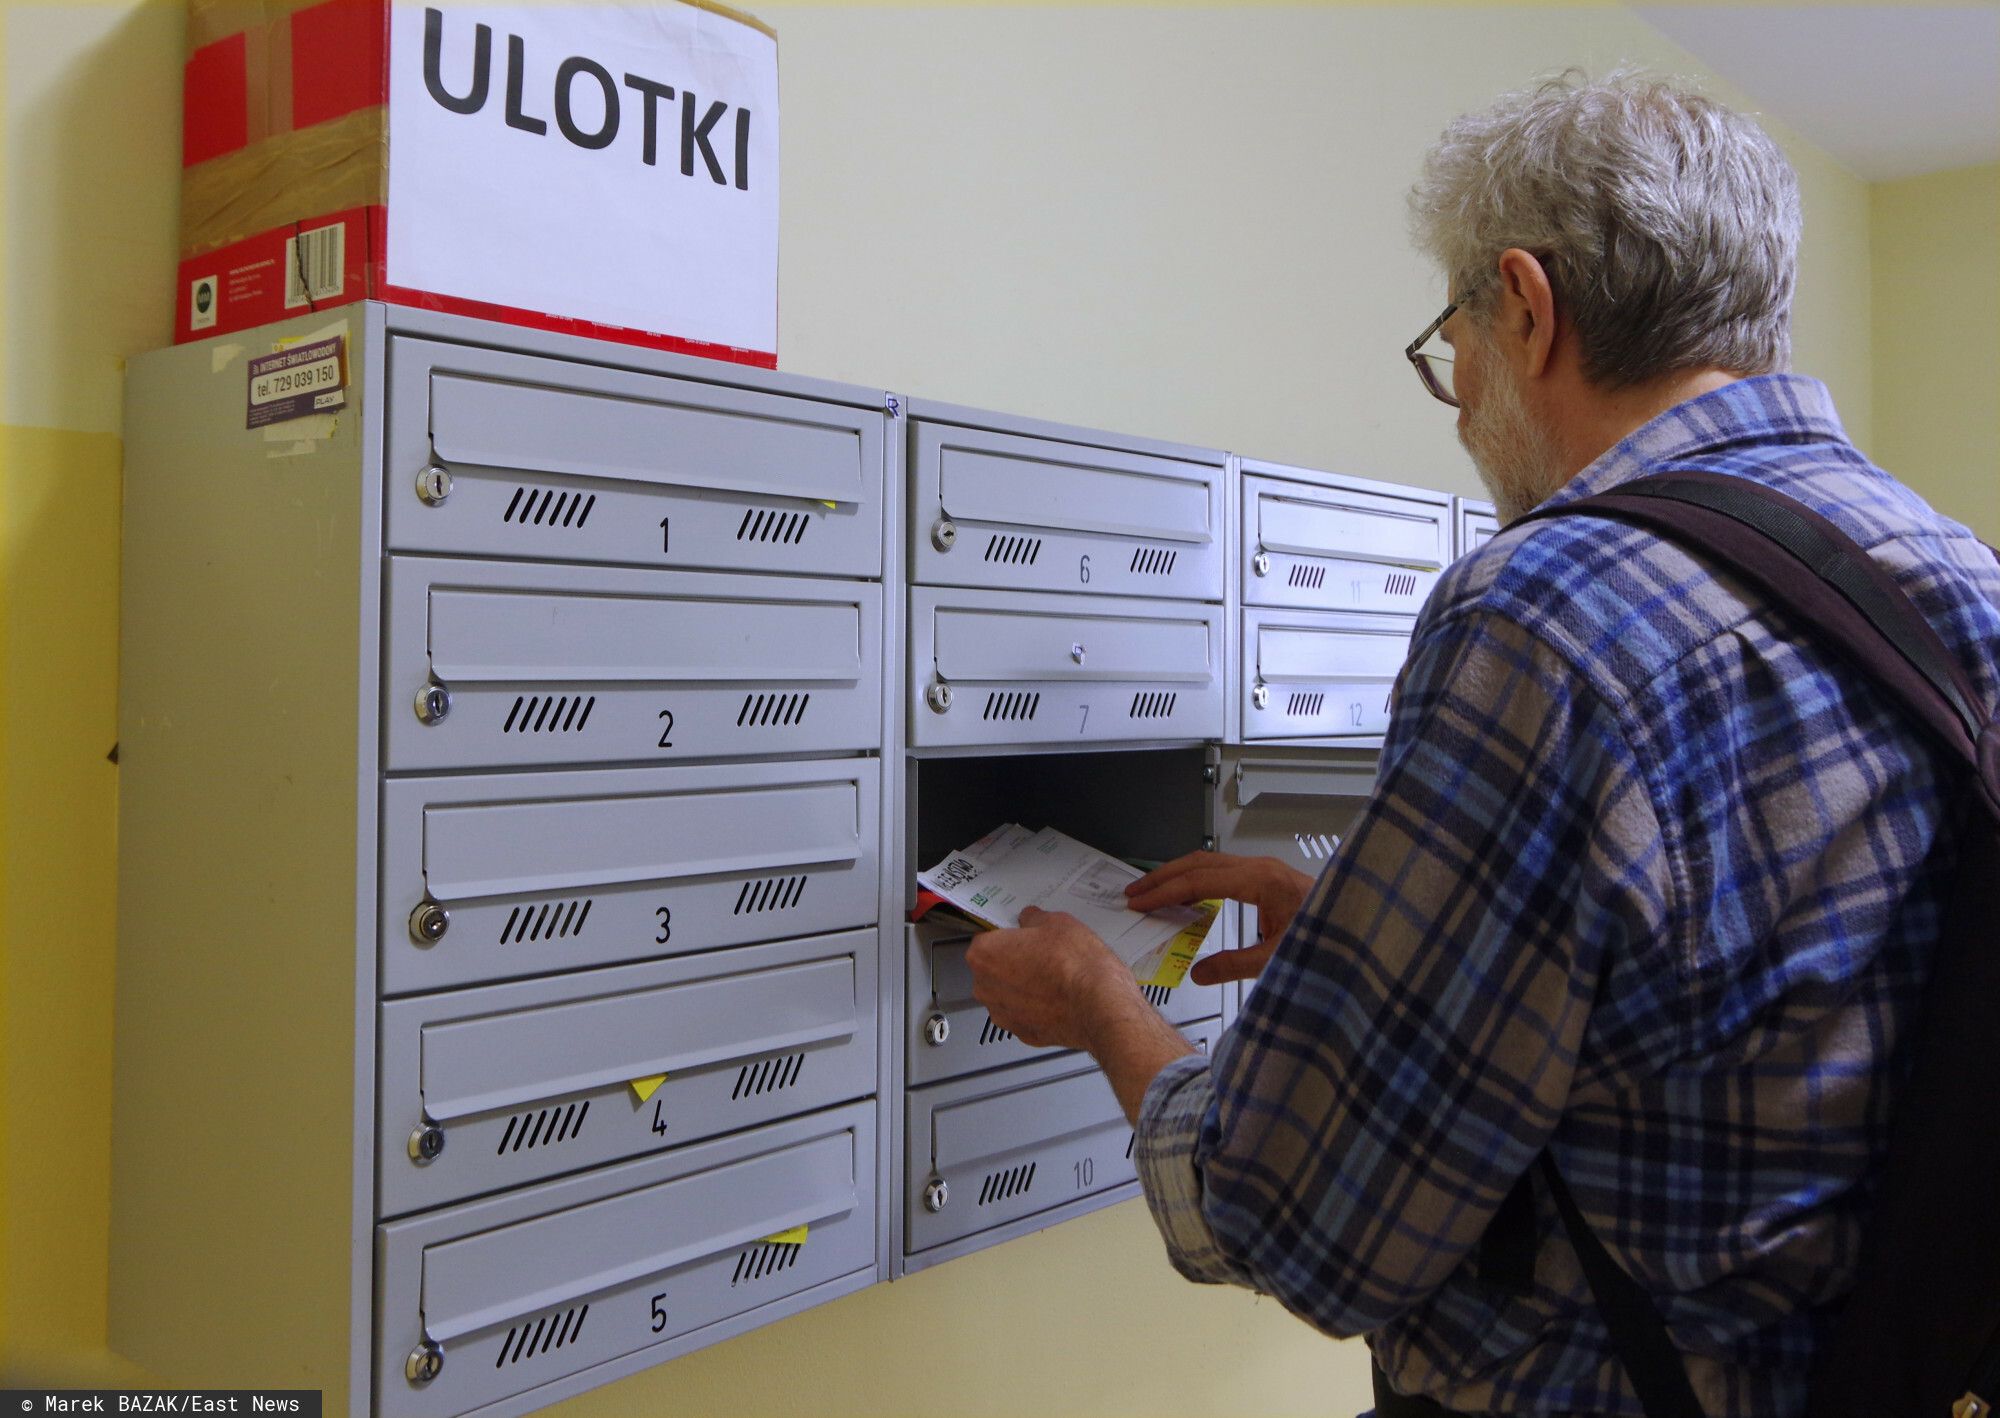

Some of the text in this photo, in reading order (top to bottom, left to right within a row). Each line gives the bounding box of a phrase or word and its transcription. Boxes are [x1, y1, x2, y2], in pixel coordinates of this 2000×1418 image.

[424, 8, 750, 190] ULOTKI
[257, 364, 334, 397] tel. 729 039 150
[315, 395, 335, 405] PLAY
[659, 517, 669, 553] 1
[1079, 555, 1091, 584] 6
[1350, 581, 1362, 603] 11
[657, 710, 673, 747] 2
[1079, 705, 1089, 734] 7
[1350, 704, 1363, 727] 12
[655, 907, 670, 944] 3
[652, 1101, 668, 1137] 4
[1073, 1157, 1094, 1189] 10
[651, 1293, 667, 1333] 5
